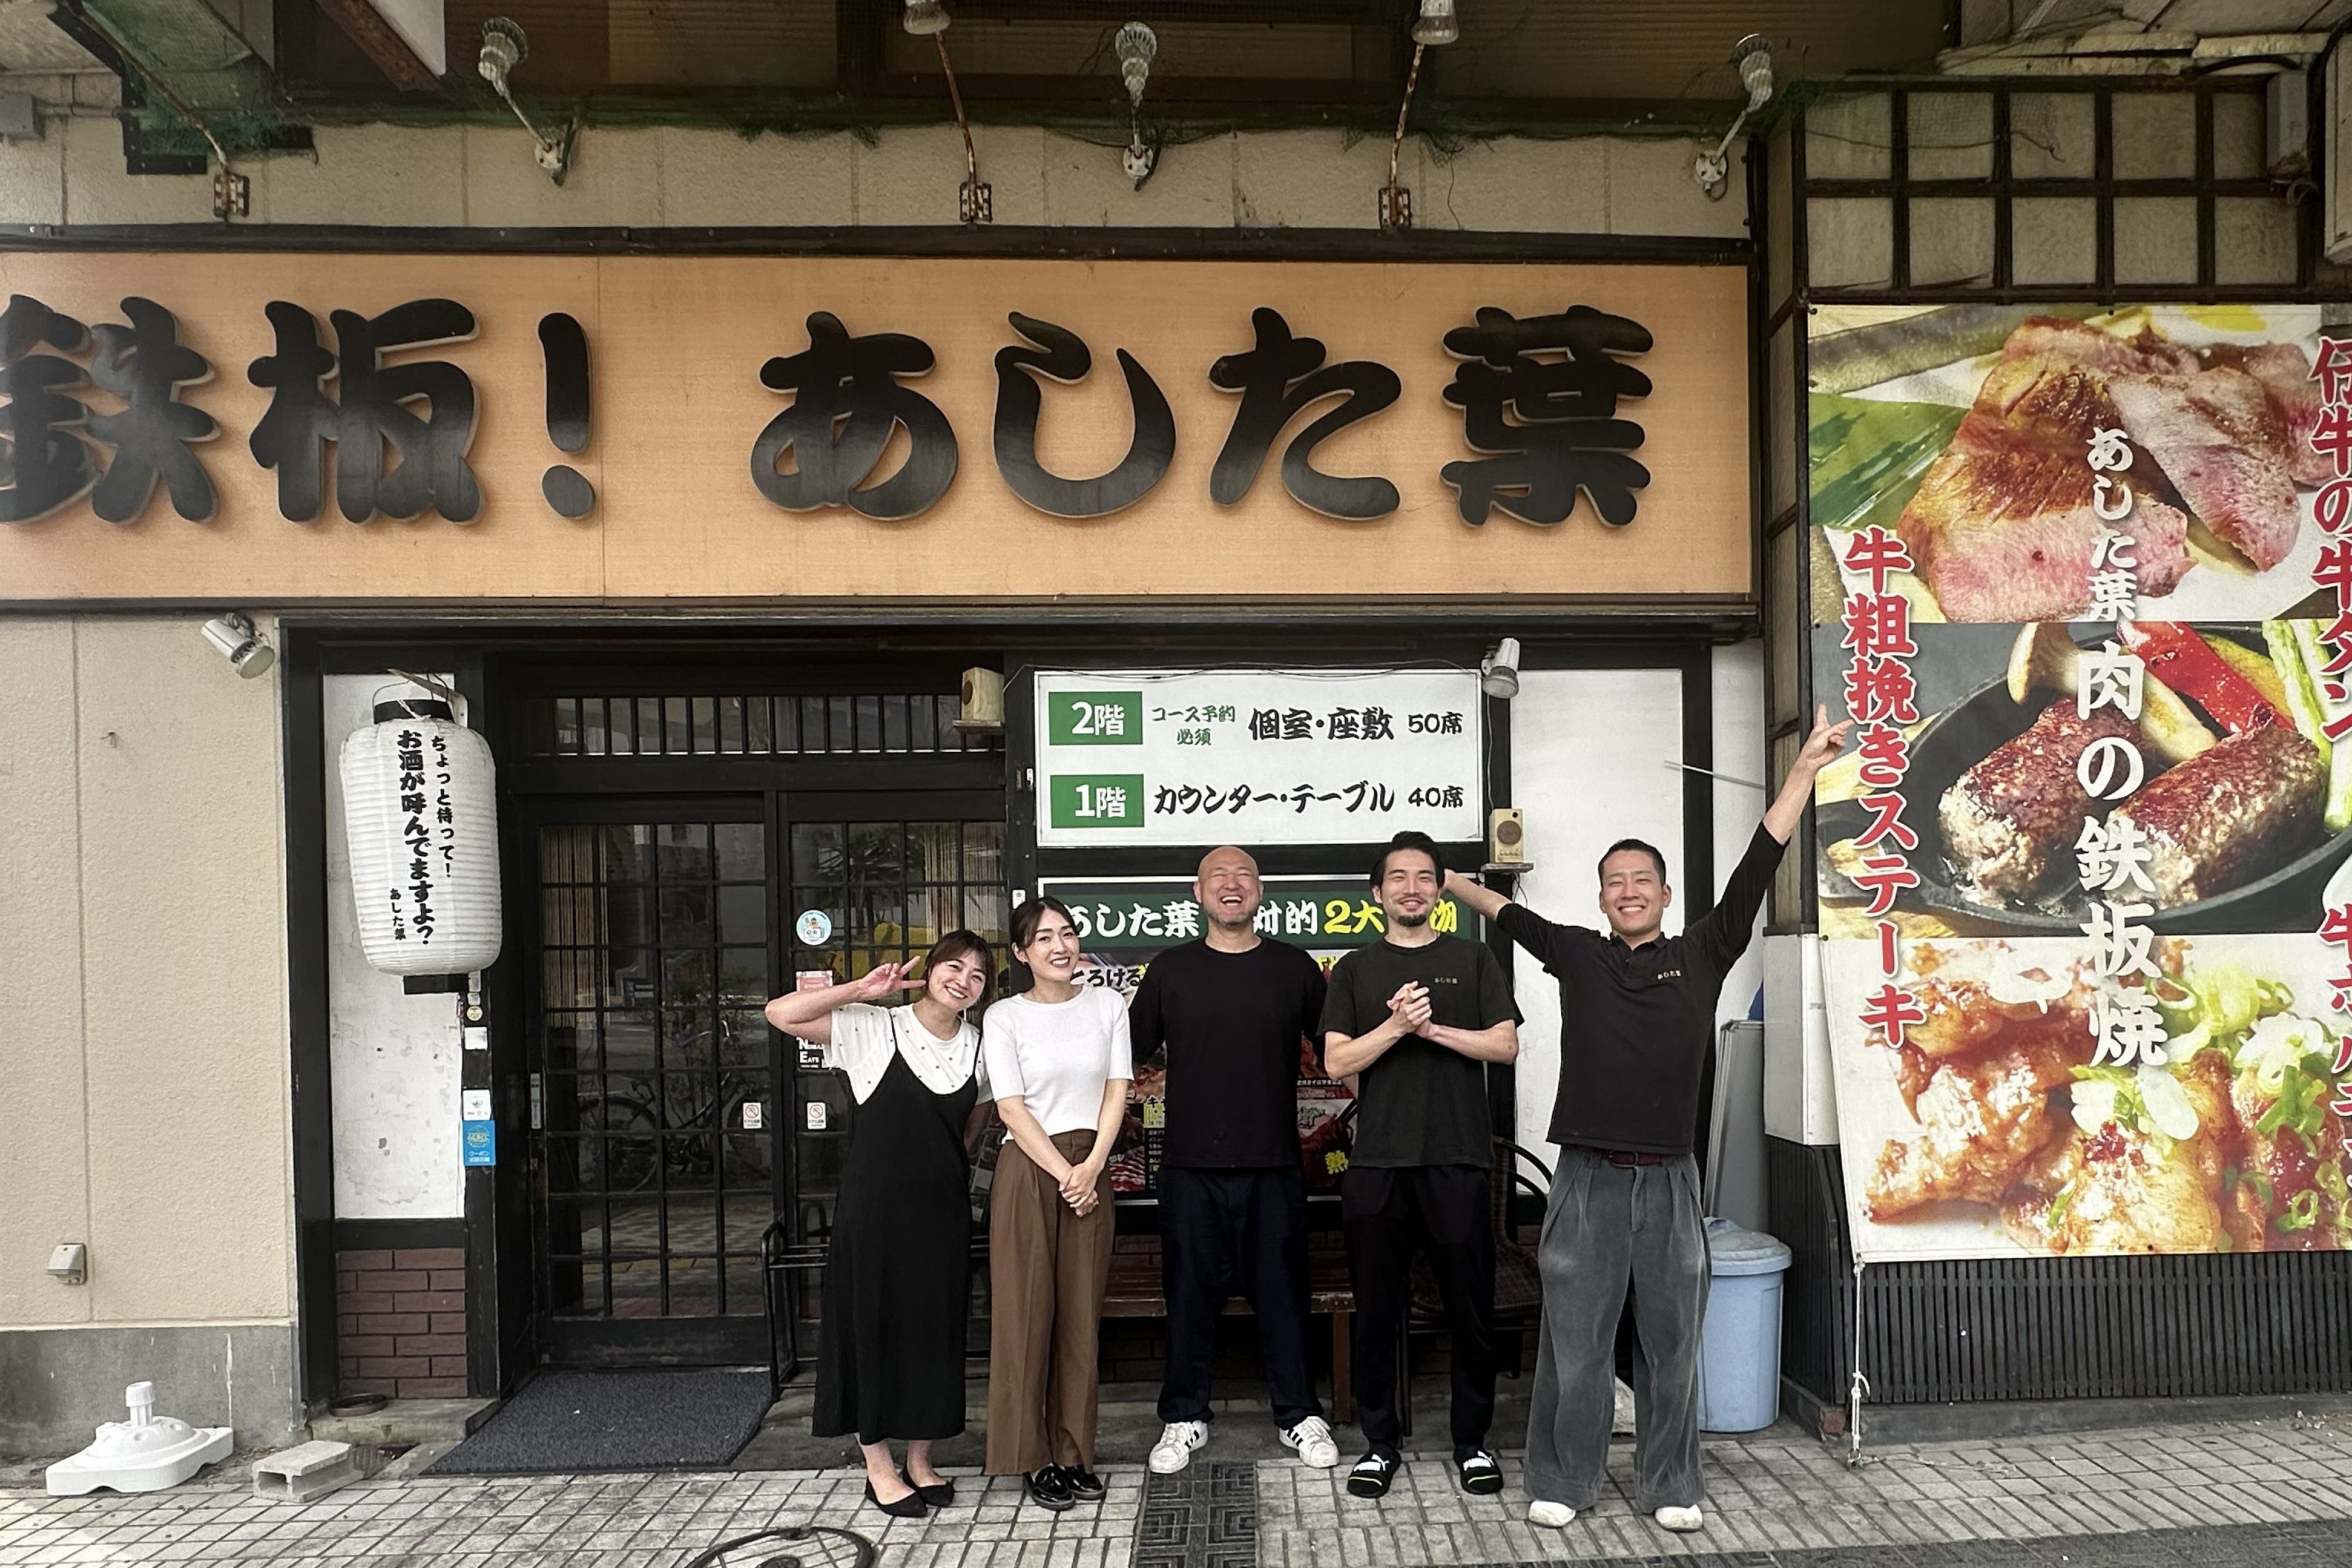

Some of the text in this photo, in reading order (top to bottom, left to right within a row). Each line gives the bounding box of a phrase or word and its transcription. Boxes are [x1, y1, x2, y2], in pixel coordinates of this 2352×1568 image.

[750, 304, 1654, 528] あした葉
[1071, 701, 1125, 736] 2階
[1151, 704, 1236, 724] コース予約
[1248, 706, 1464, 741] 個室・座敷 50席
[1176, 728, 1212, 746] 必須
[1074, 783, 1127, 819] 1階
[1153, 780, 1464, 815] カウンター・テーブル 40席
[1841, 525, 1927, 1048] 牛粗挽きステーキ
[389, 888, 407, 940] あした葉
